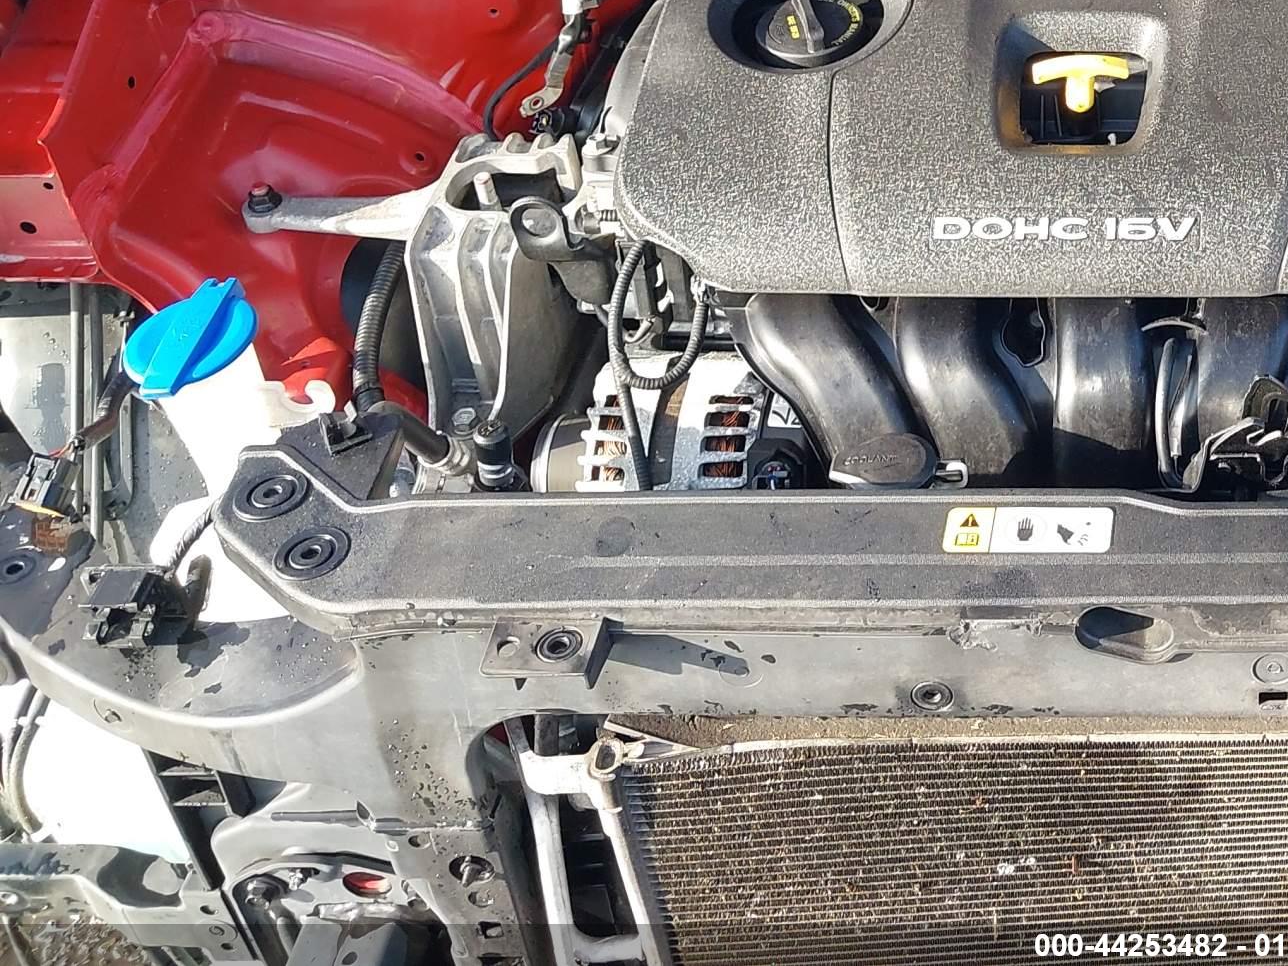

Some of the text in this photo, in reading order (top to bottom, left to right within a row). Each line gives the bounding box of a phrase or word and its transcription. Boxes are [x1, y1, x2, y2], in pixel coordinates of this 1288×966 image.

[933, 217, 1196, 241] DOHC 16V
[843, 454, 898, 466] COOLANT
